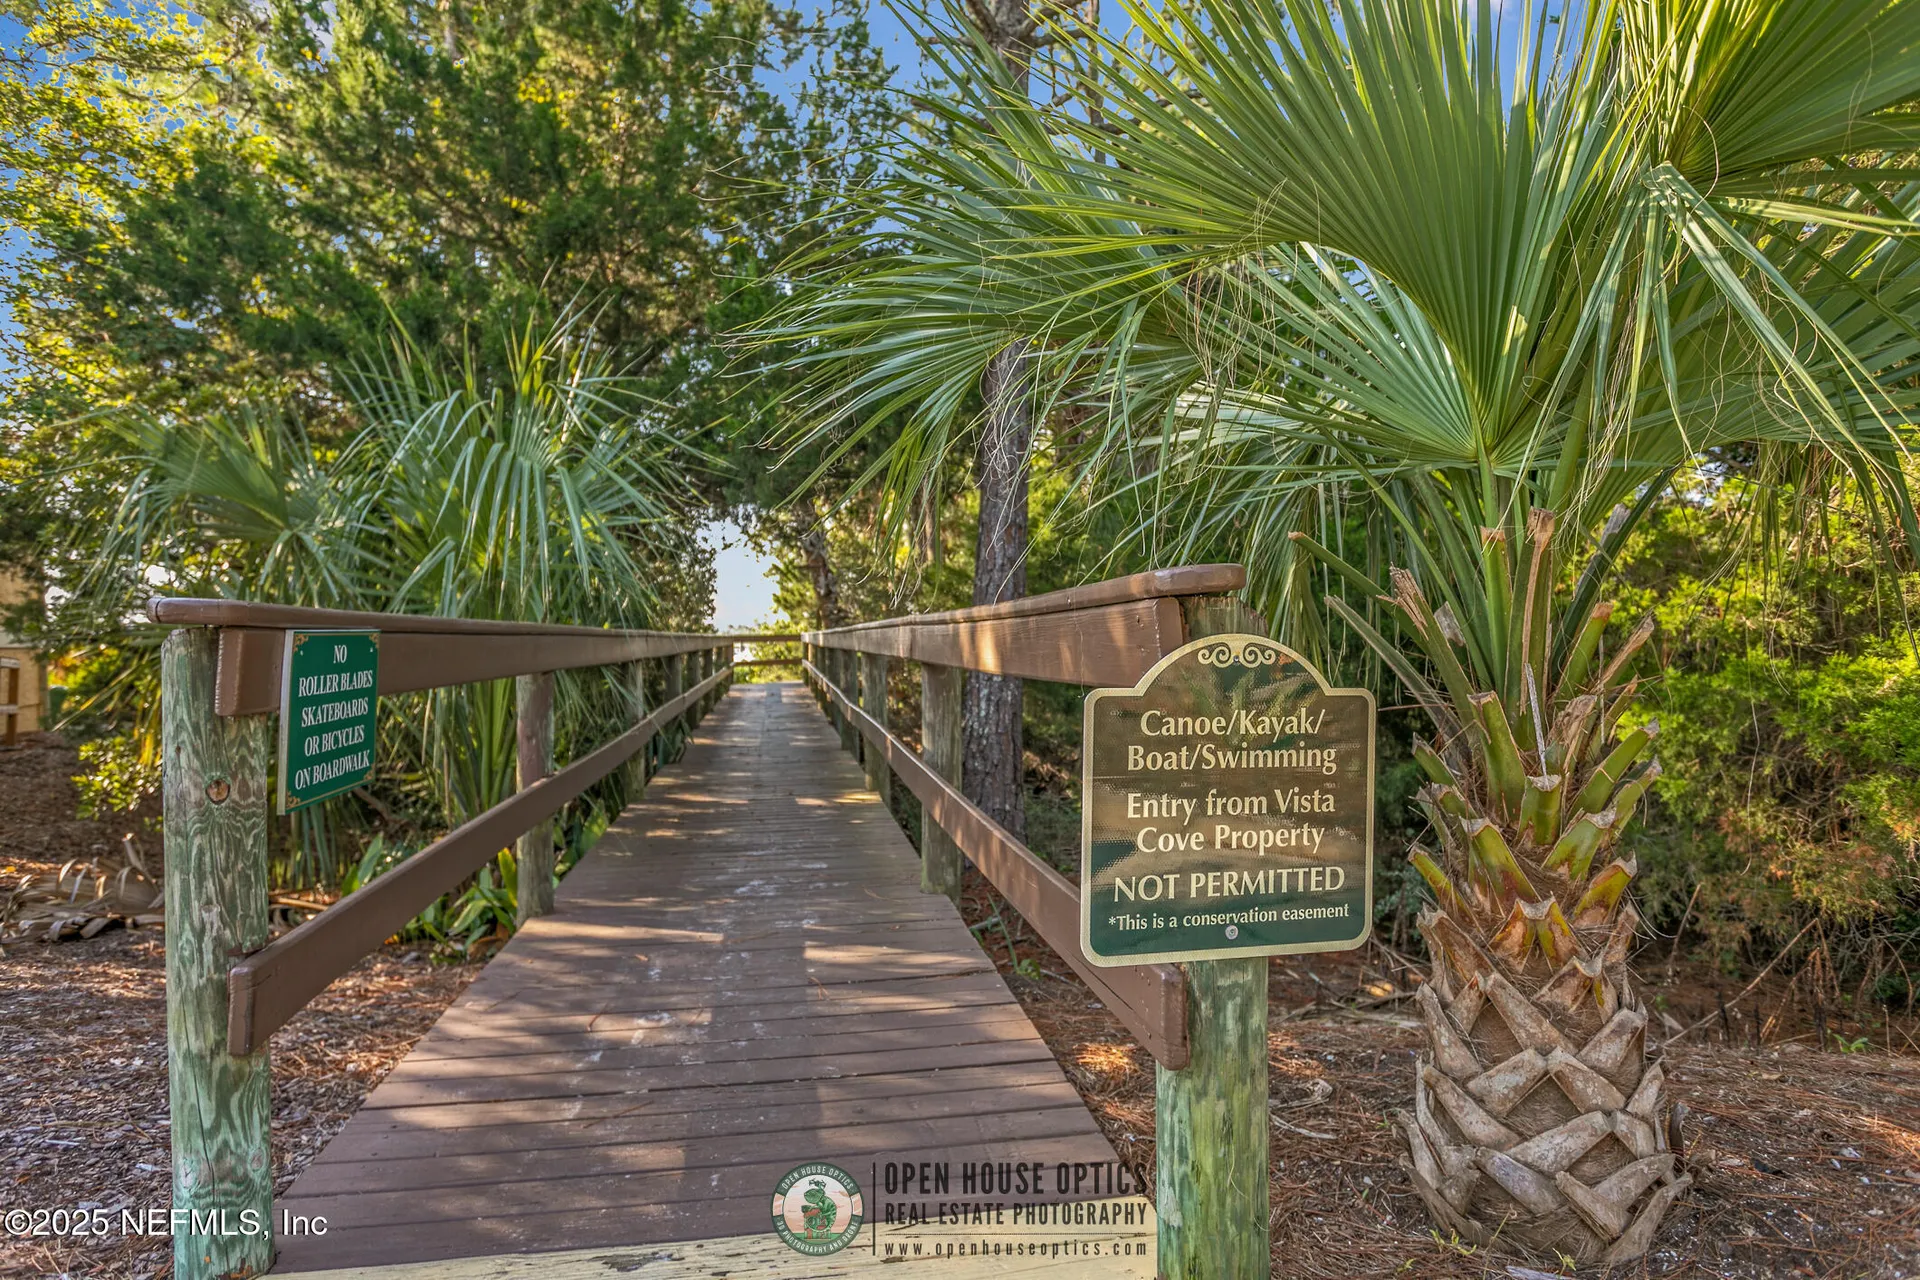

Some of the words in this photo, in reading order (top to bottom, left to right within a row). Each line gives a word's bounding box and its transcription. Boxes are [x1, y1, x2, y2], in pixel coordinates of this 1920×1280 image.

[333, 645, 347, 663] NO
[299, 674, 339, 697] ROLLER
[341, 670, 373, 692] BLADES
[302, 697, 368, 727] SKATEBOARDS
[1140, 707, 1326, 742] Canoe/Kayak/
[305, 736, 319, 757] OR
[322, 725, 365, 753] BICYCLES
[295, 768, 310, 790] ON
[312, 750, 370, 784] BOARDWALK
[1127, 741, 1337, 775] Boat/Swimming
[1127, 792, 1197, 825] Entry
[1206, 789, 1267, 816] from
[1274, 786, 1335, 813] Vista
[1137, 827, 1204, 853] Cove
[1215, 823, 1325, 856] Property
[1113, 874, 1180, 902] NOT
[1190, 866, 1345, 898] PERMITTED
[1153, 912, 1164, 928] is
[1169, 917, 1178, 928] a
[1183, 907, 1277, 927] conservation
[1282, 903, 1349, 920] easement
